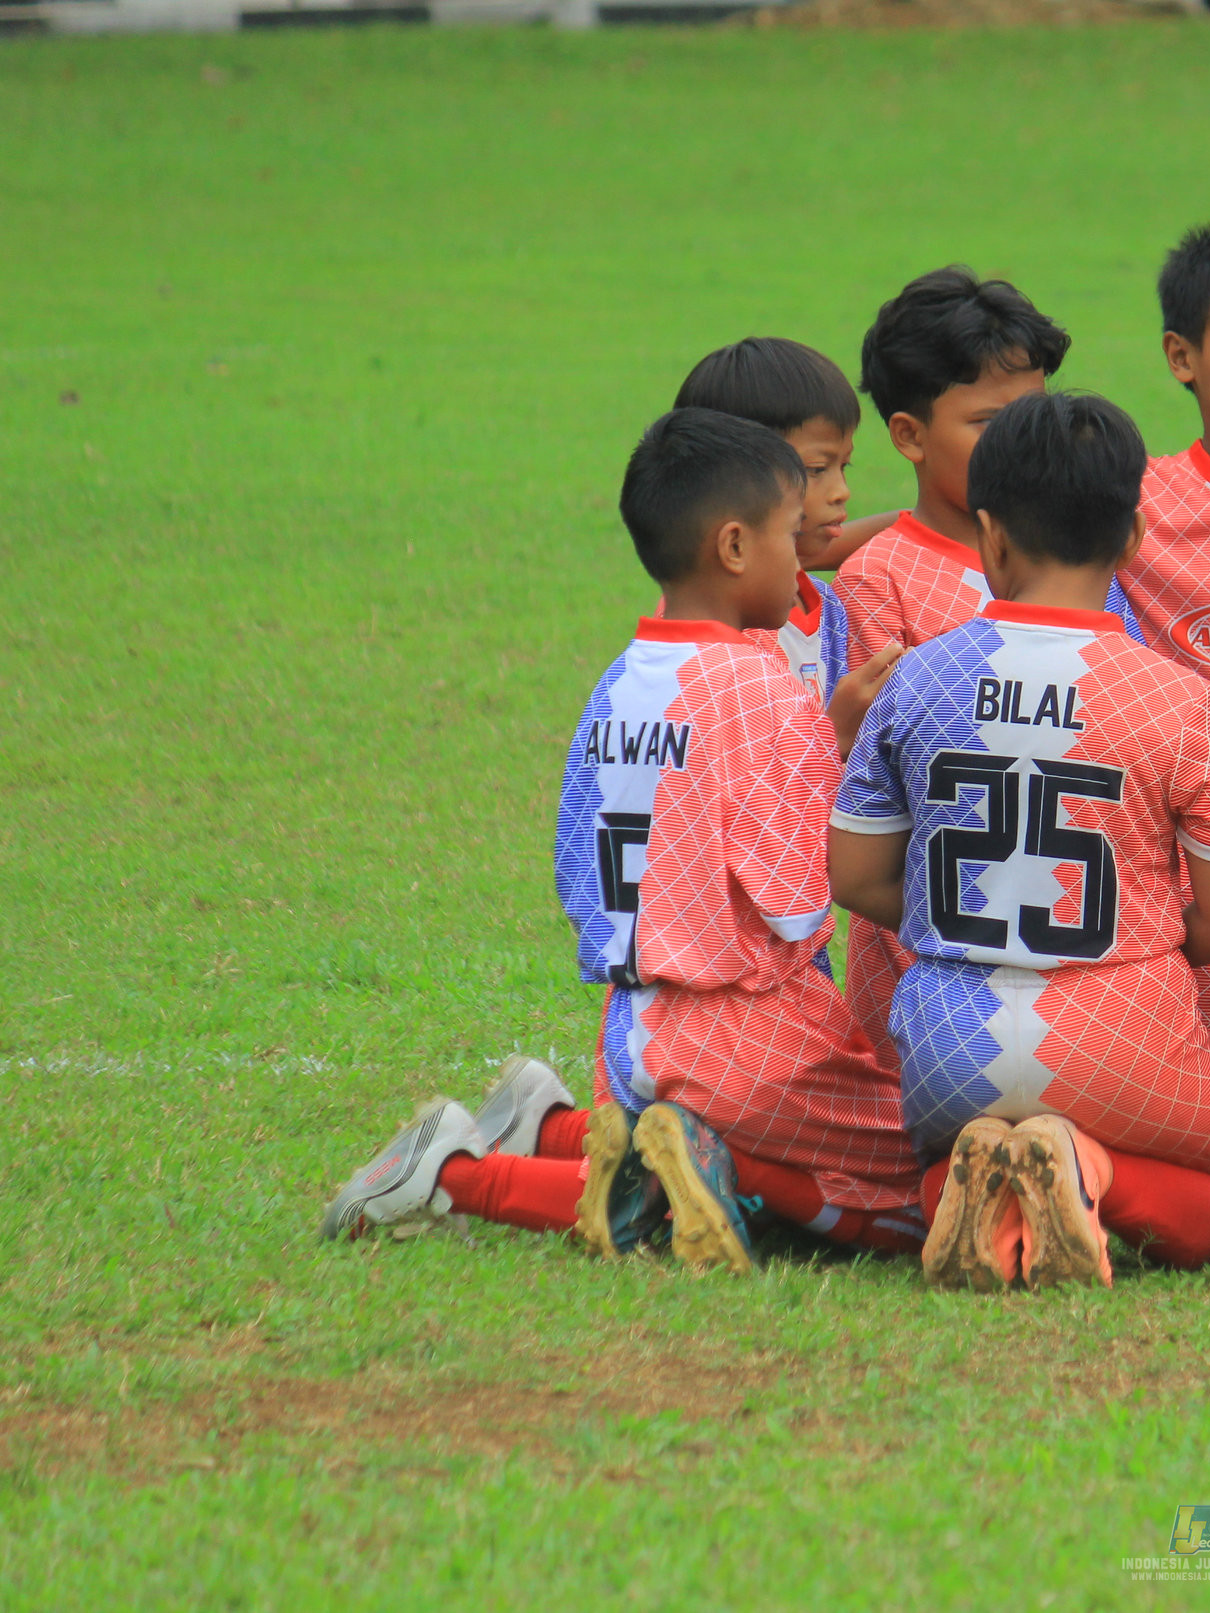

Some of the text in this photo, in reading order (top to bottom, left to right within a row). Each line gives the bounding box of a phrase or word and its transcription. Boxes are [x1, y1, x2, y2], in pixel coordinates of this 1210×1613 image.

[976, 678, 1085, 731] BILAL
[585, 720, 690, 769] ALWAN
[927, 750, 1126, 958] 25
